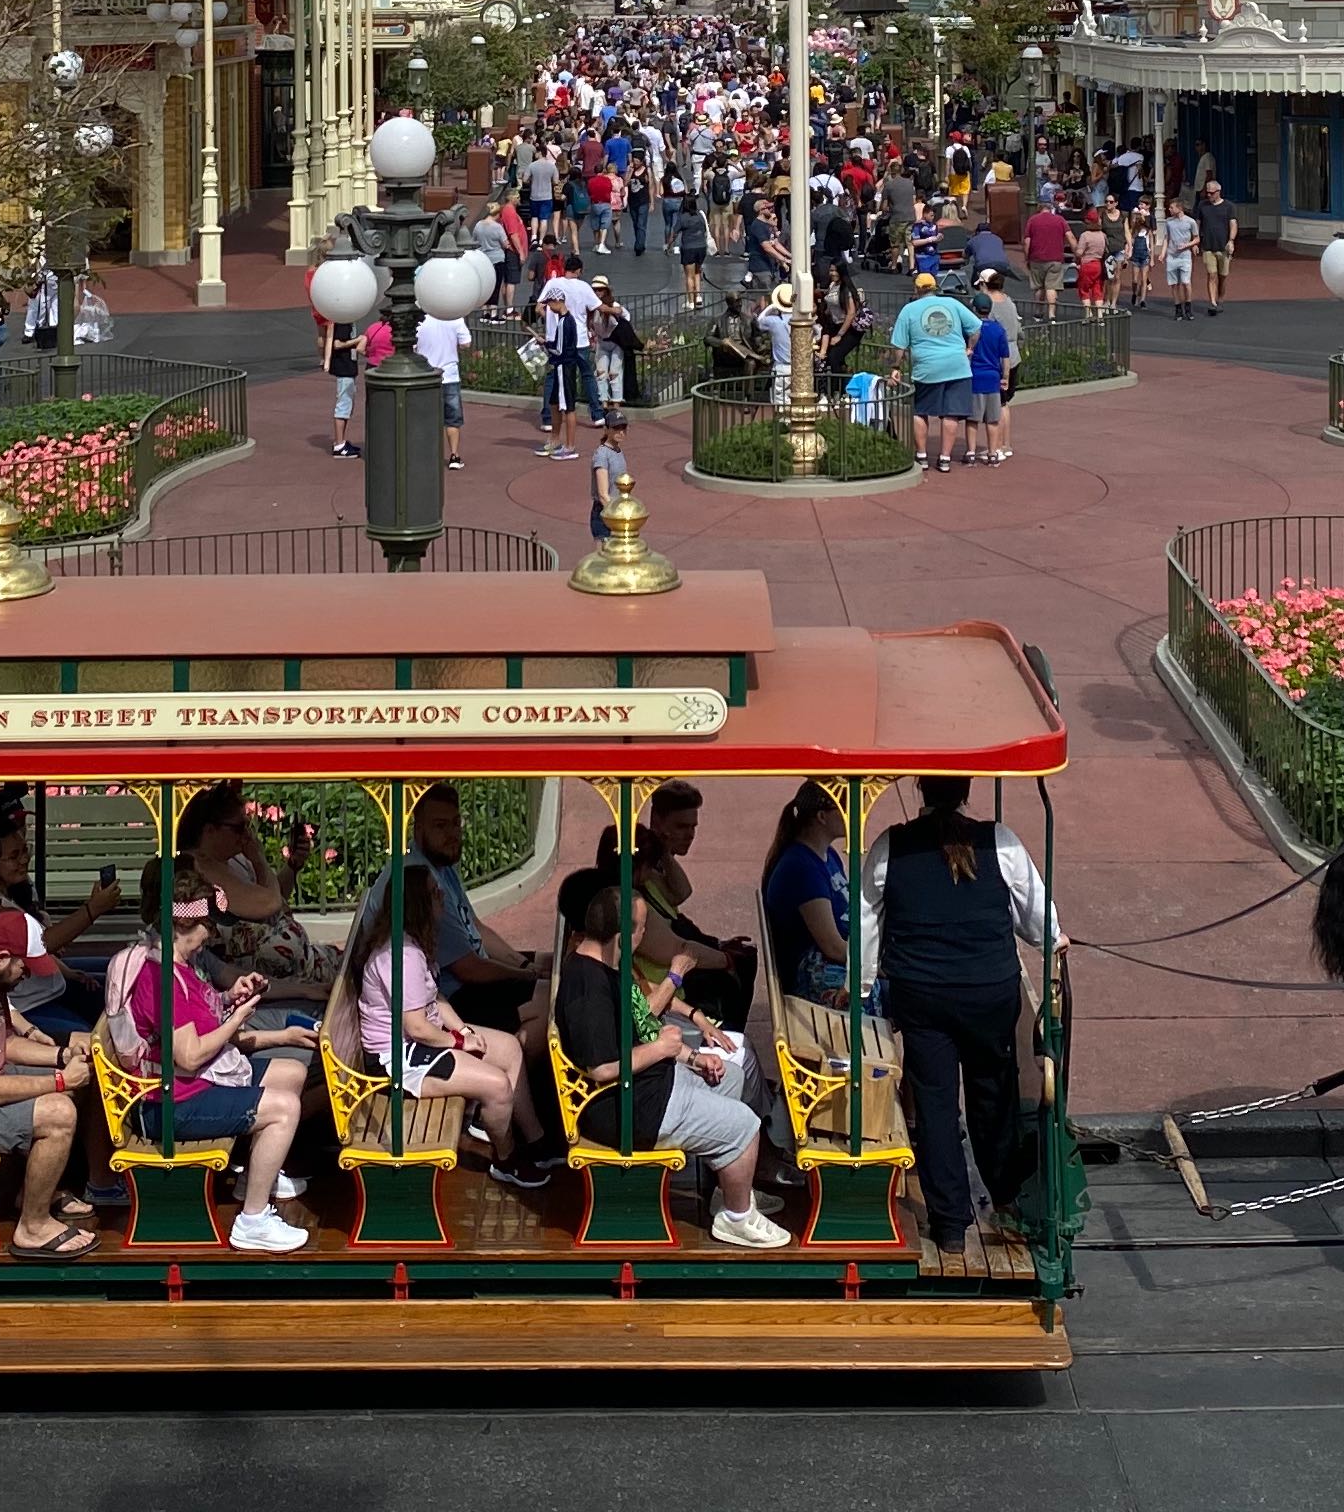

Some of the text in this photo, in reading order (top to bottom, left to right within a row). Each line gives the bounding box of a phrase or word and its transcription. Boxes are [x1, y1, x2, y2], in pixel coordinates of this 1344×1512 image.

[30, 709, 157, 728] STREET
[177, 706, 462, 725] TRANSPORTATION
[482, 705, 634, 724] COMPANY
